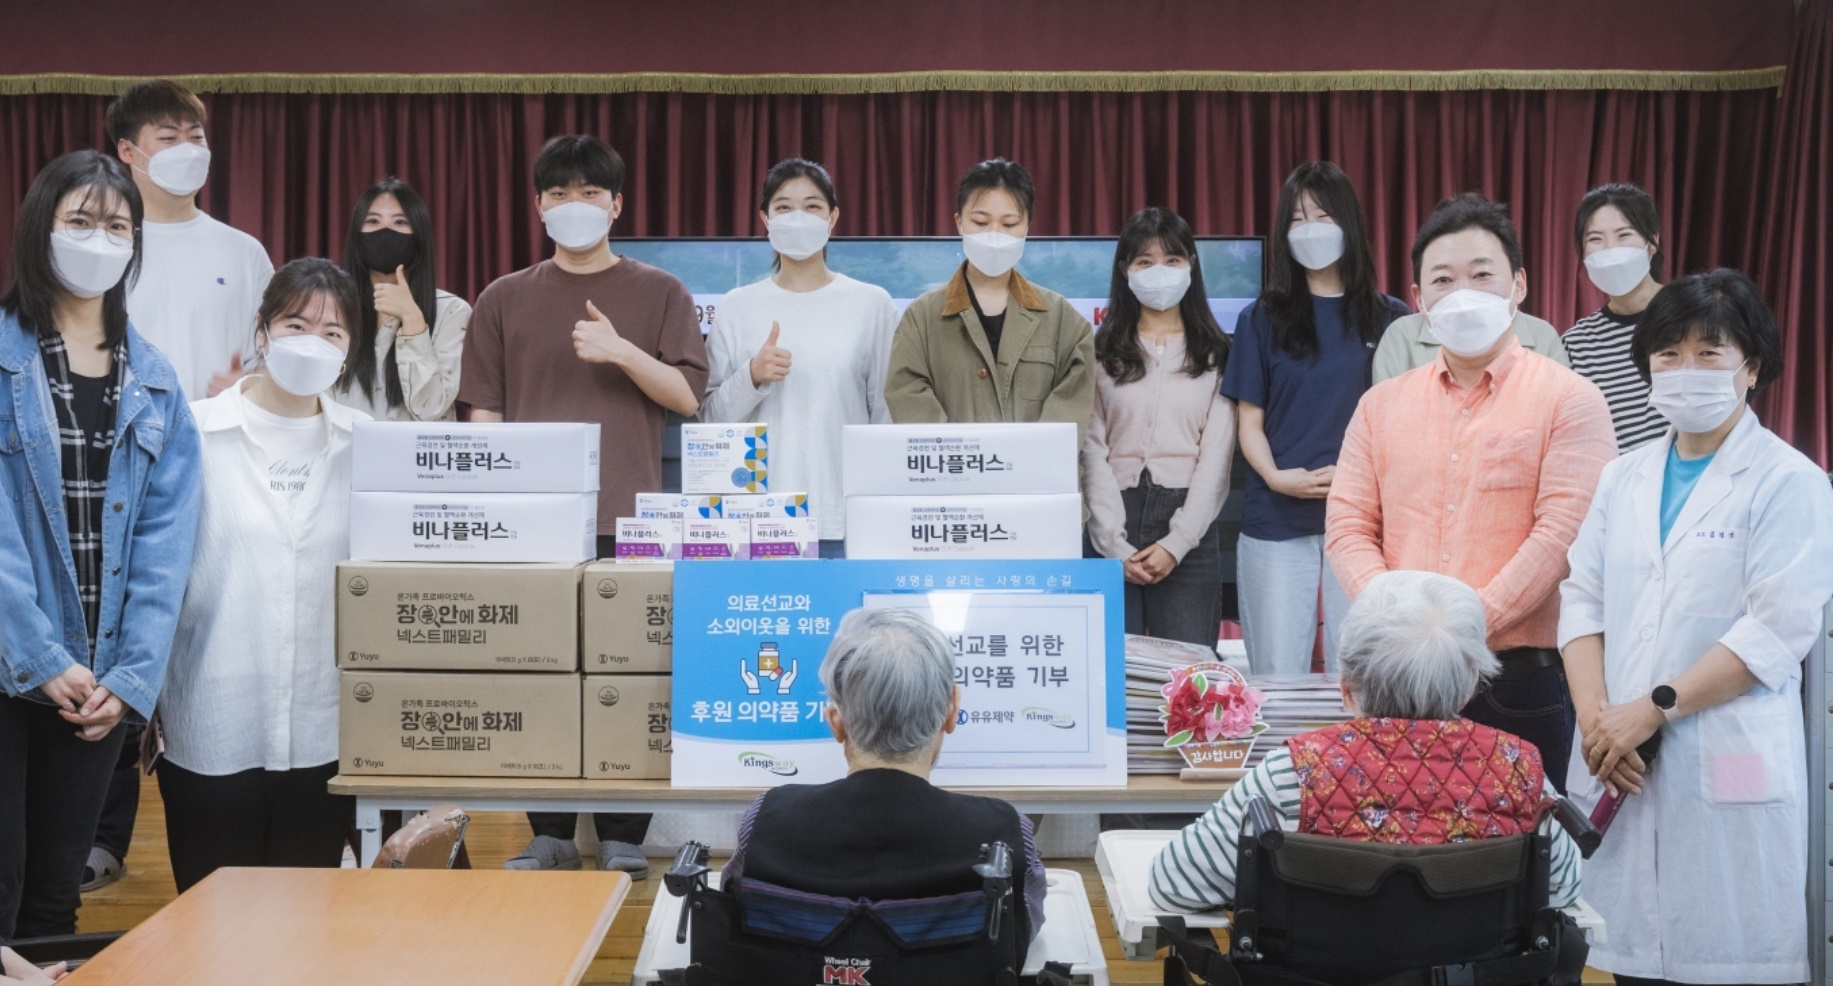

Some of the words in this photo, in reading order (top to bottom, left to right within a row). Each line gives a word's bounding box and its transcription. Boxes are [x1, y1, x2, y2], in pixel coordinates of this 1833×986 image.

[416, 451, 512, 471] 비나플러스
[907, 454, 1004, 473] 비나플러스
[413, 521, 509, 541] 비나플러스
[911, 523, 1008, 543] 비나플러스
[895, 575, 934, 587] 생명을
[945, 575, 985, 587] 살리는
[996, 575, 1035, 587] 사랑의
[1047, 575, 1072, 587] 손길
[727, 595, 811, 612] 의료선교와
[478, 604, 518, 625] 화제
[646, 606, 667, 626] 장
[707, 618, 791, 635] 소외이웃을
[797, 617, 831, 635] 위한
[397, 629, 486, 644] 넥스트패밀리
[1020, 635, 1064, 656] 위한
[359, 653, 379, 661] Yuyu
[609, 655, 628, 664] Yuyu
[954, 666, 1016, 688] 의약품
[1027, 666, 1069, 687] 기부
[691, 701, 732, 722] 후원
[737, 701, 800, 722] 의약품
[970, 711, 1015, 723] 유유제약
[482, 711, 522, 732] 화제
[648, 713, 668, 733] 장
[401, 736, 490, 751] 넥스트패밀리
[364, 759, 384, 768] Yuyu
[744, 757, 795, 768] Kingsway
[1191, 749, 1244, 763] 감사합니다
[611, 763, 630, 771] Yuyu
[824, 956, 849, 965] Wheel
[851, 958, 871, 966] Chair
[823, 965, 871, 985] MK
